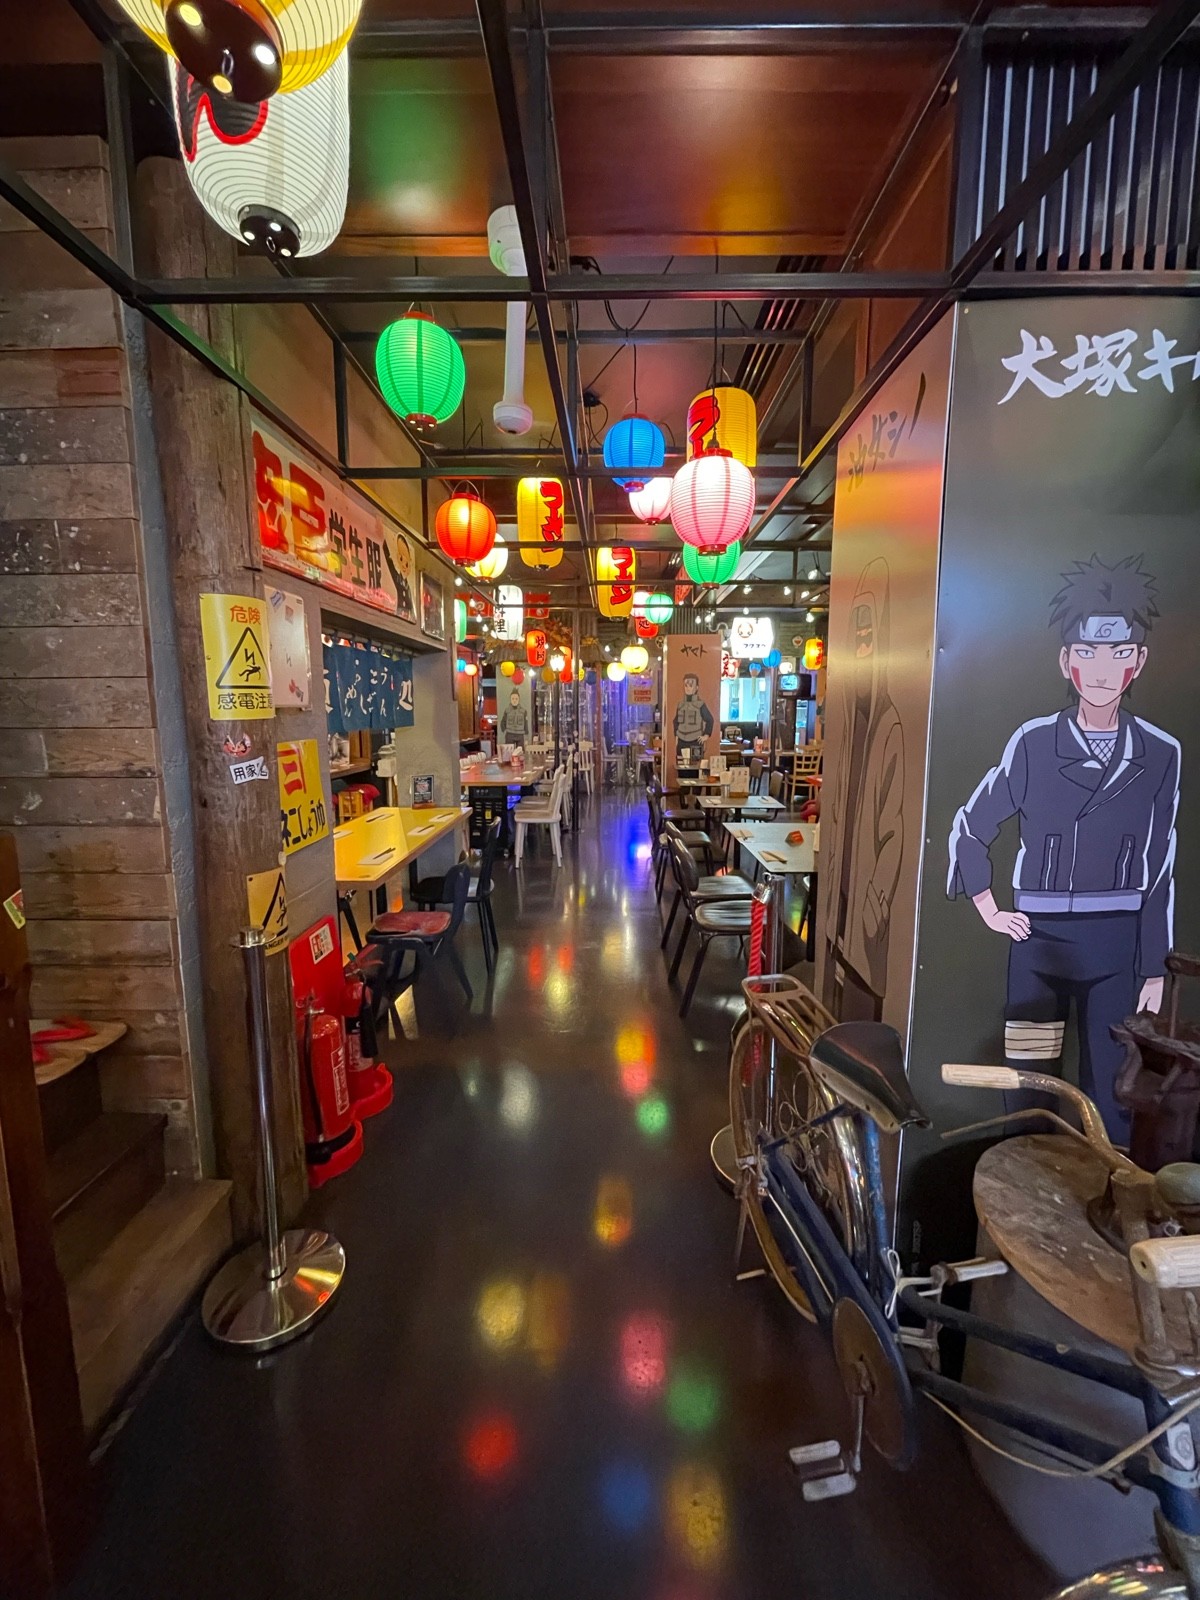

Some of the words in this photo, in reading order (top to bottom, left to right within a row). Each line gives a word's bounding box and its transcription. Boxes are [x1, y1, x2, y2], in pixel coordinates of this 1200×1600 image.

[997, 328, 1200, 405] 犬塚キ
[230, 605, 261, 625] 危険
[680, 644, 707, 658] ヤマト
